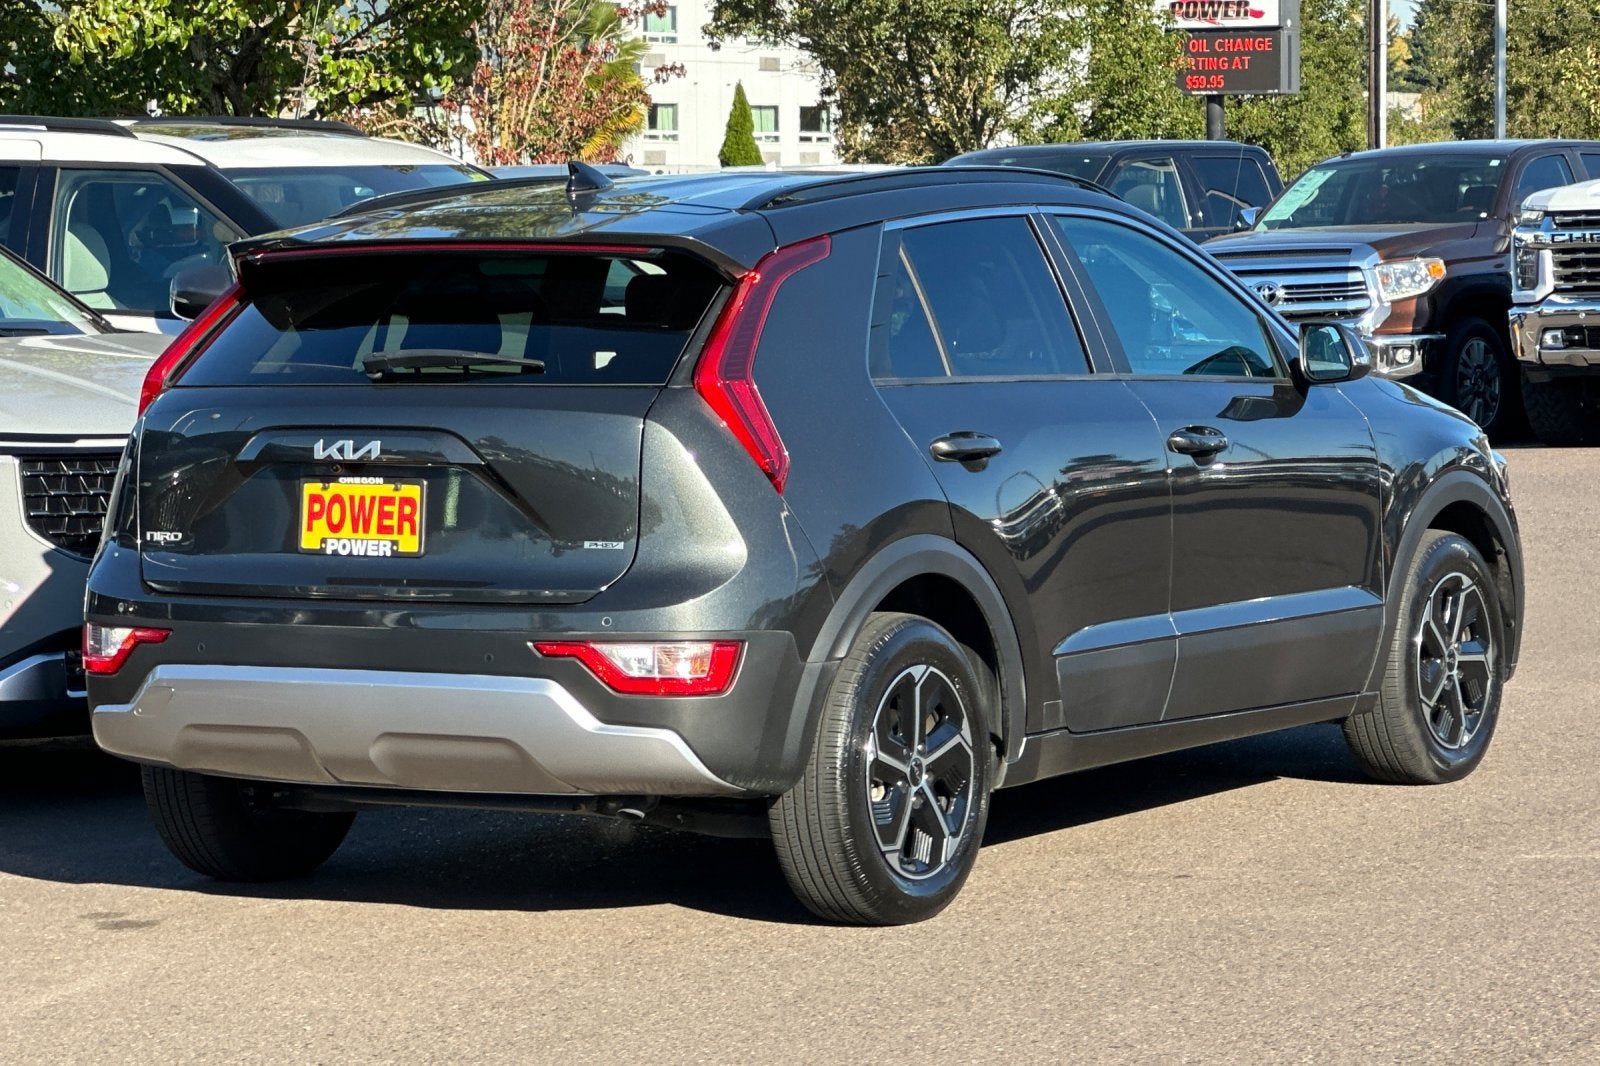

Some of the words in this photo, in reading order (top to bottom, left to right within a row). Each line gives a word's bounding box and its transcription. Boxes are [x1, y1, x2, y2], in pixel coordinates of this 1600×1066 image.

[1169, 0, 1250, 19] POWER
[1189, 39, 1210, 52] OIL
[1215, 38, 1273, 51] CHANGE
[1232, 56, 1251, 69] AT
[1186, 75, 1225, 89] $59.95
[313, 438, 382, 460] KIA
[338, 477, 384, 485] OREGON
[306, 493, 418, 535] POWER
[326, 538, 392, 557] POWER
